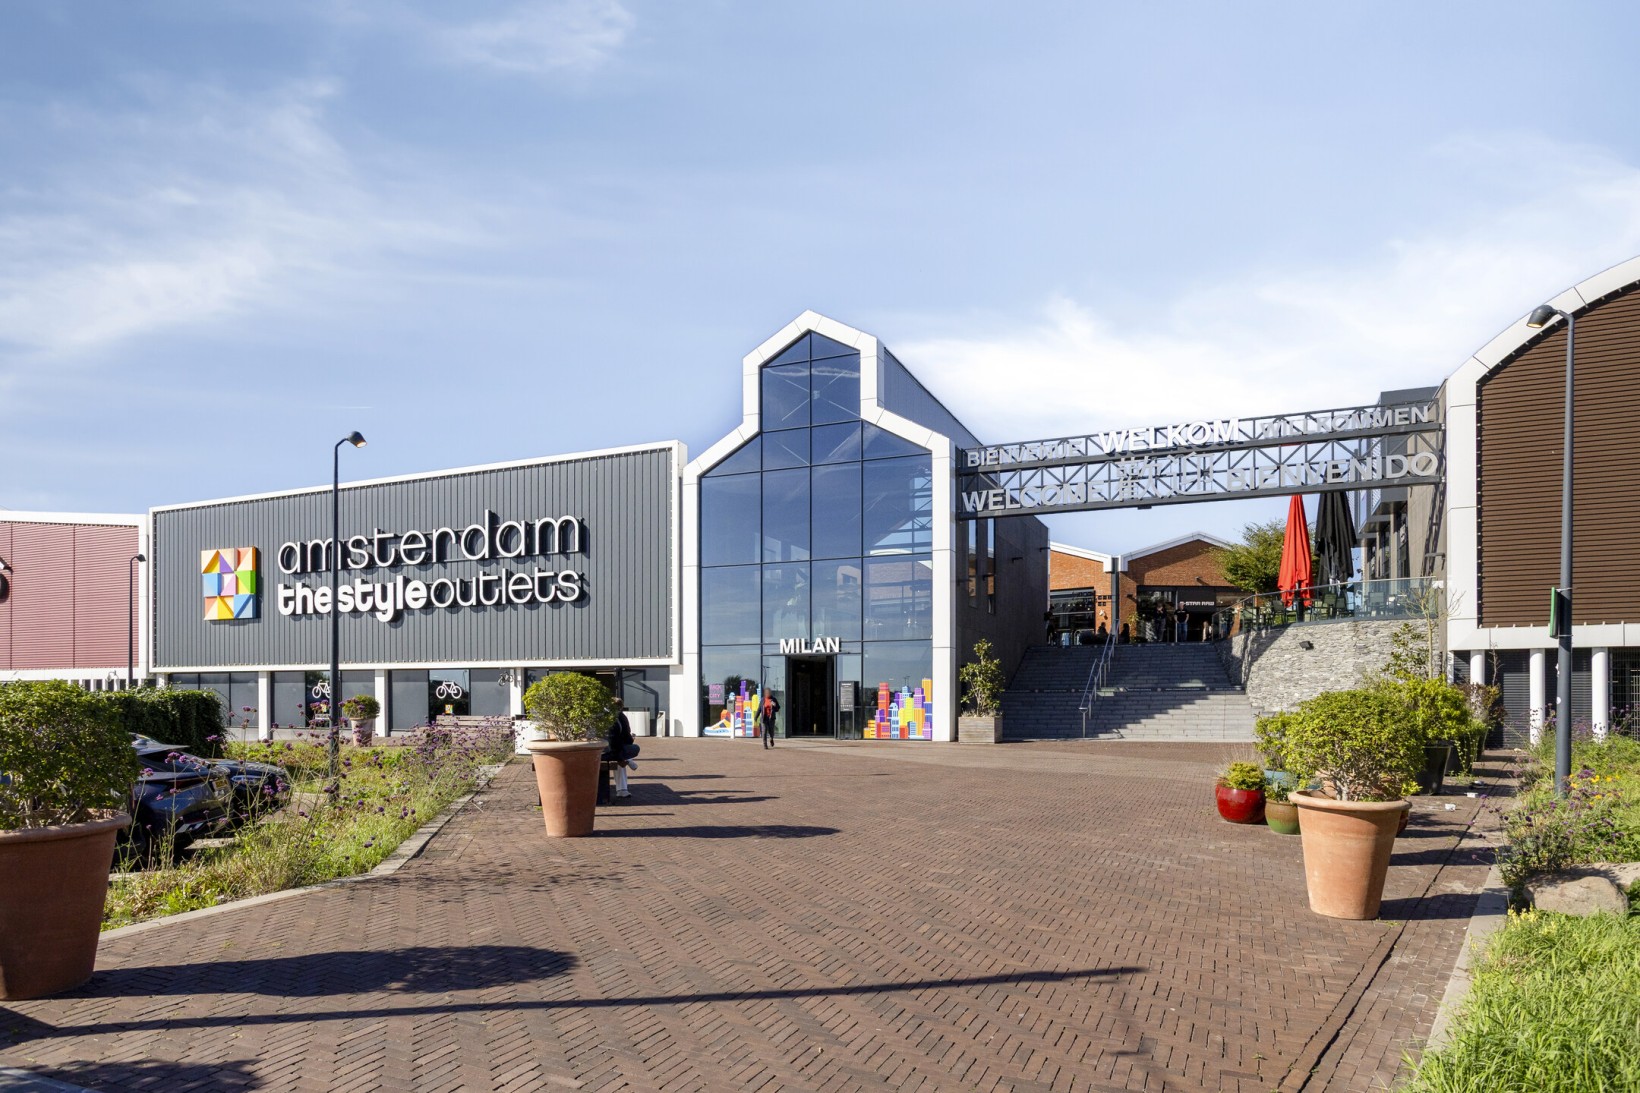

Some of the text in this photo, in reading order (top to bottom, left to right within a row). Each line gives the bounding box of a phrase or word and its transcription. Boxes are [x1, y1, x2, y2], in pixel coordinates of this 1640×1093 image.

[967, 406, 1429, 467] BIENVENUE WELKOM WILLKOMMEN
[1227, 452, 1439, 492] BIENVENIDO
[961, 480, 1105, 512] WELCOME
[277, 508, 582, 575] amsterdam
[779, 637, 841, 654] MILAN
